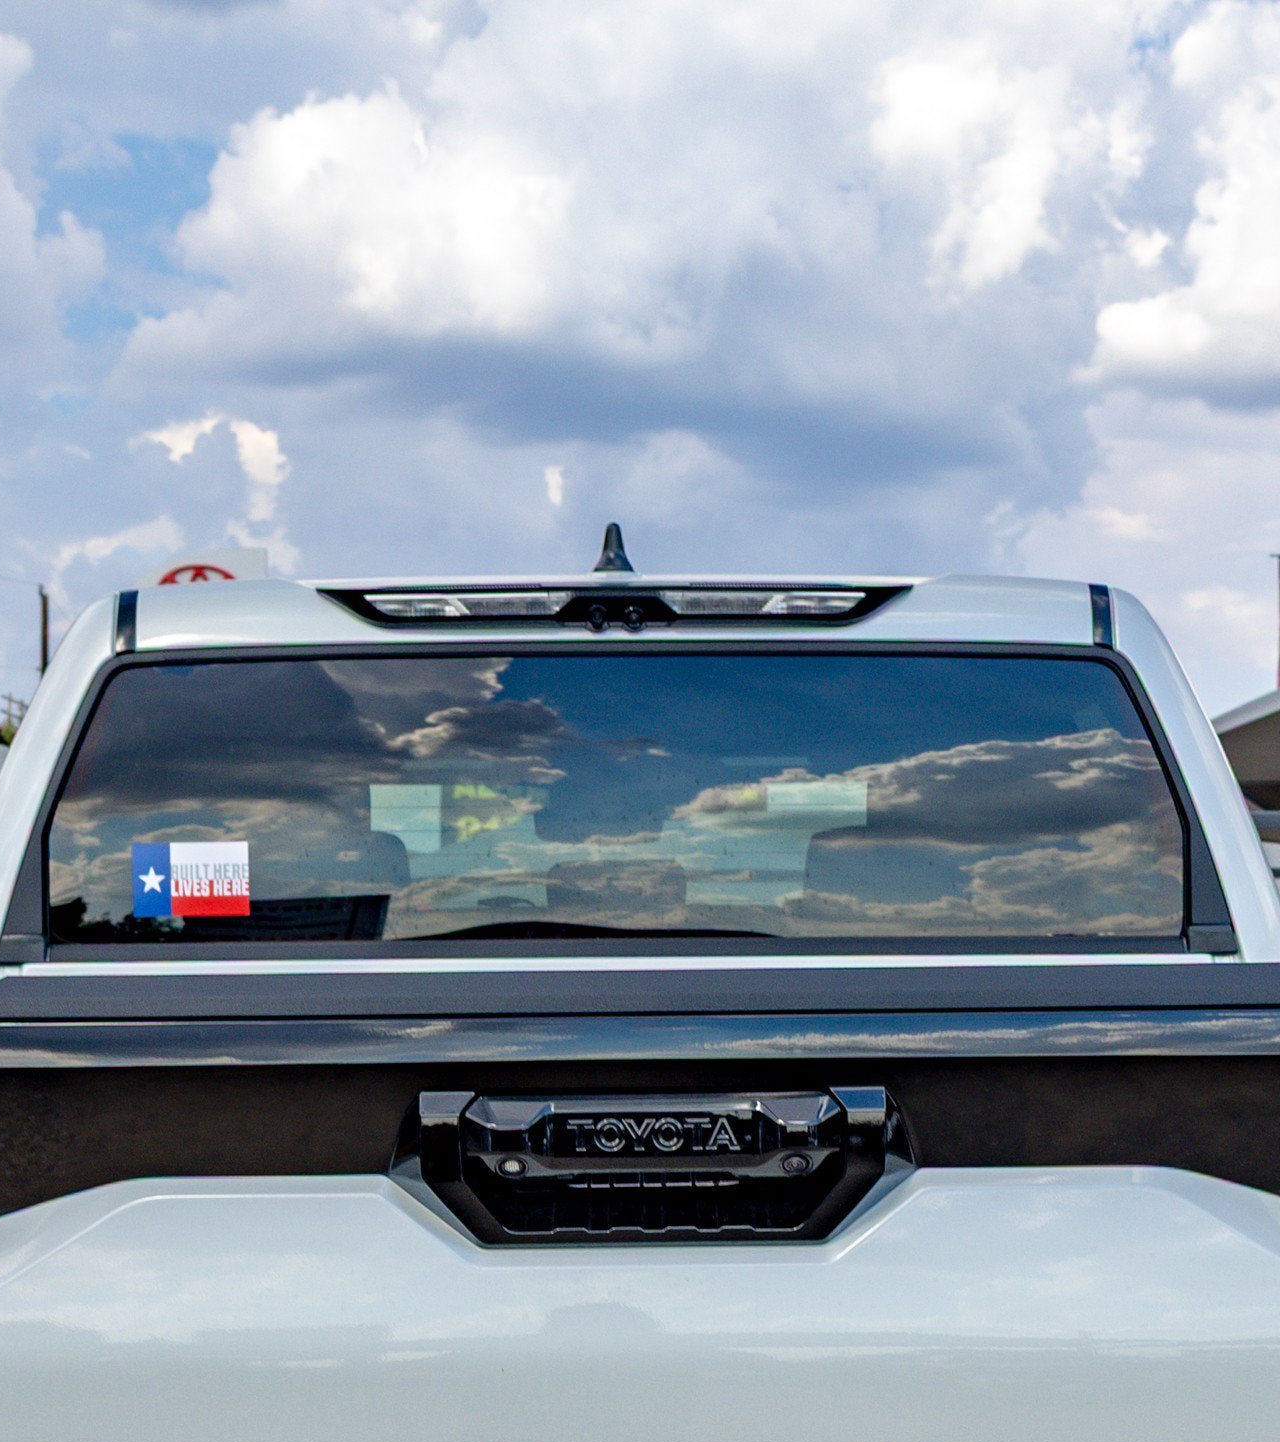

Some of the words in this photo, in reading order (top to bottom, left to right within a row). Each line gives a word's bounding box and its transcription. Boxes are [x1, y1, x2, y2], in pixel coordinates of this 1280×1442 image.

[171, 863, 210, 880] BUILT
[213, 863, 249, 880] HERE
[171, 880, 210, 896] LIVES
[213, 880, 250, 896] HERE
[566, 1117, 742, 1153] TOYOTA
